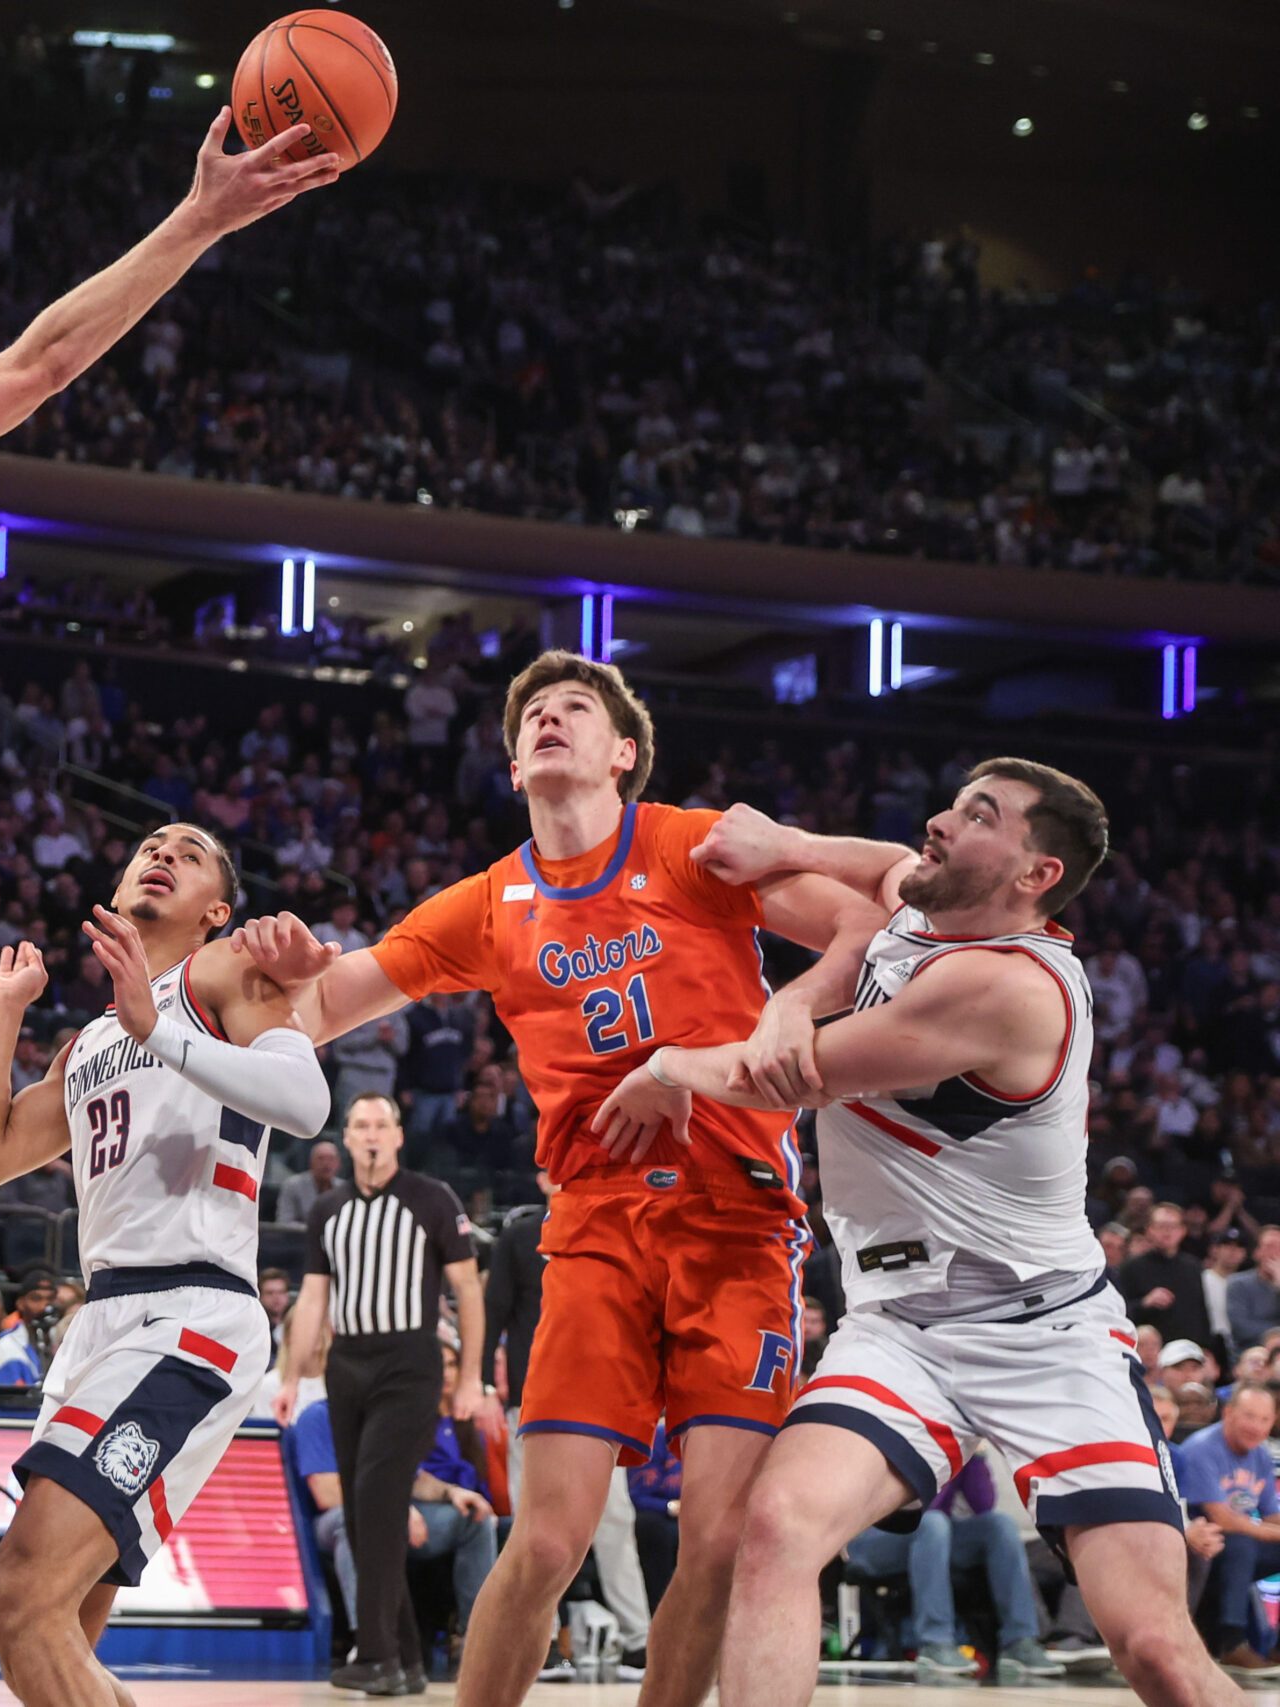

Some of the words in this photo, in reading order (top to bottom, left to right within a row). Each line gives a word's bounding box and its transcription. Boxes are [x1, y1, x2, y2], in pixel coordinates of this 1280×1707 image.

[630, 874, 648, 890] SEC
[538, 923, 663, 988] Gators
[581, 973, 656, 1056] 21
[86, 1088, 131, 1180] 23
[745, 1328, 793, 1393] F
